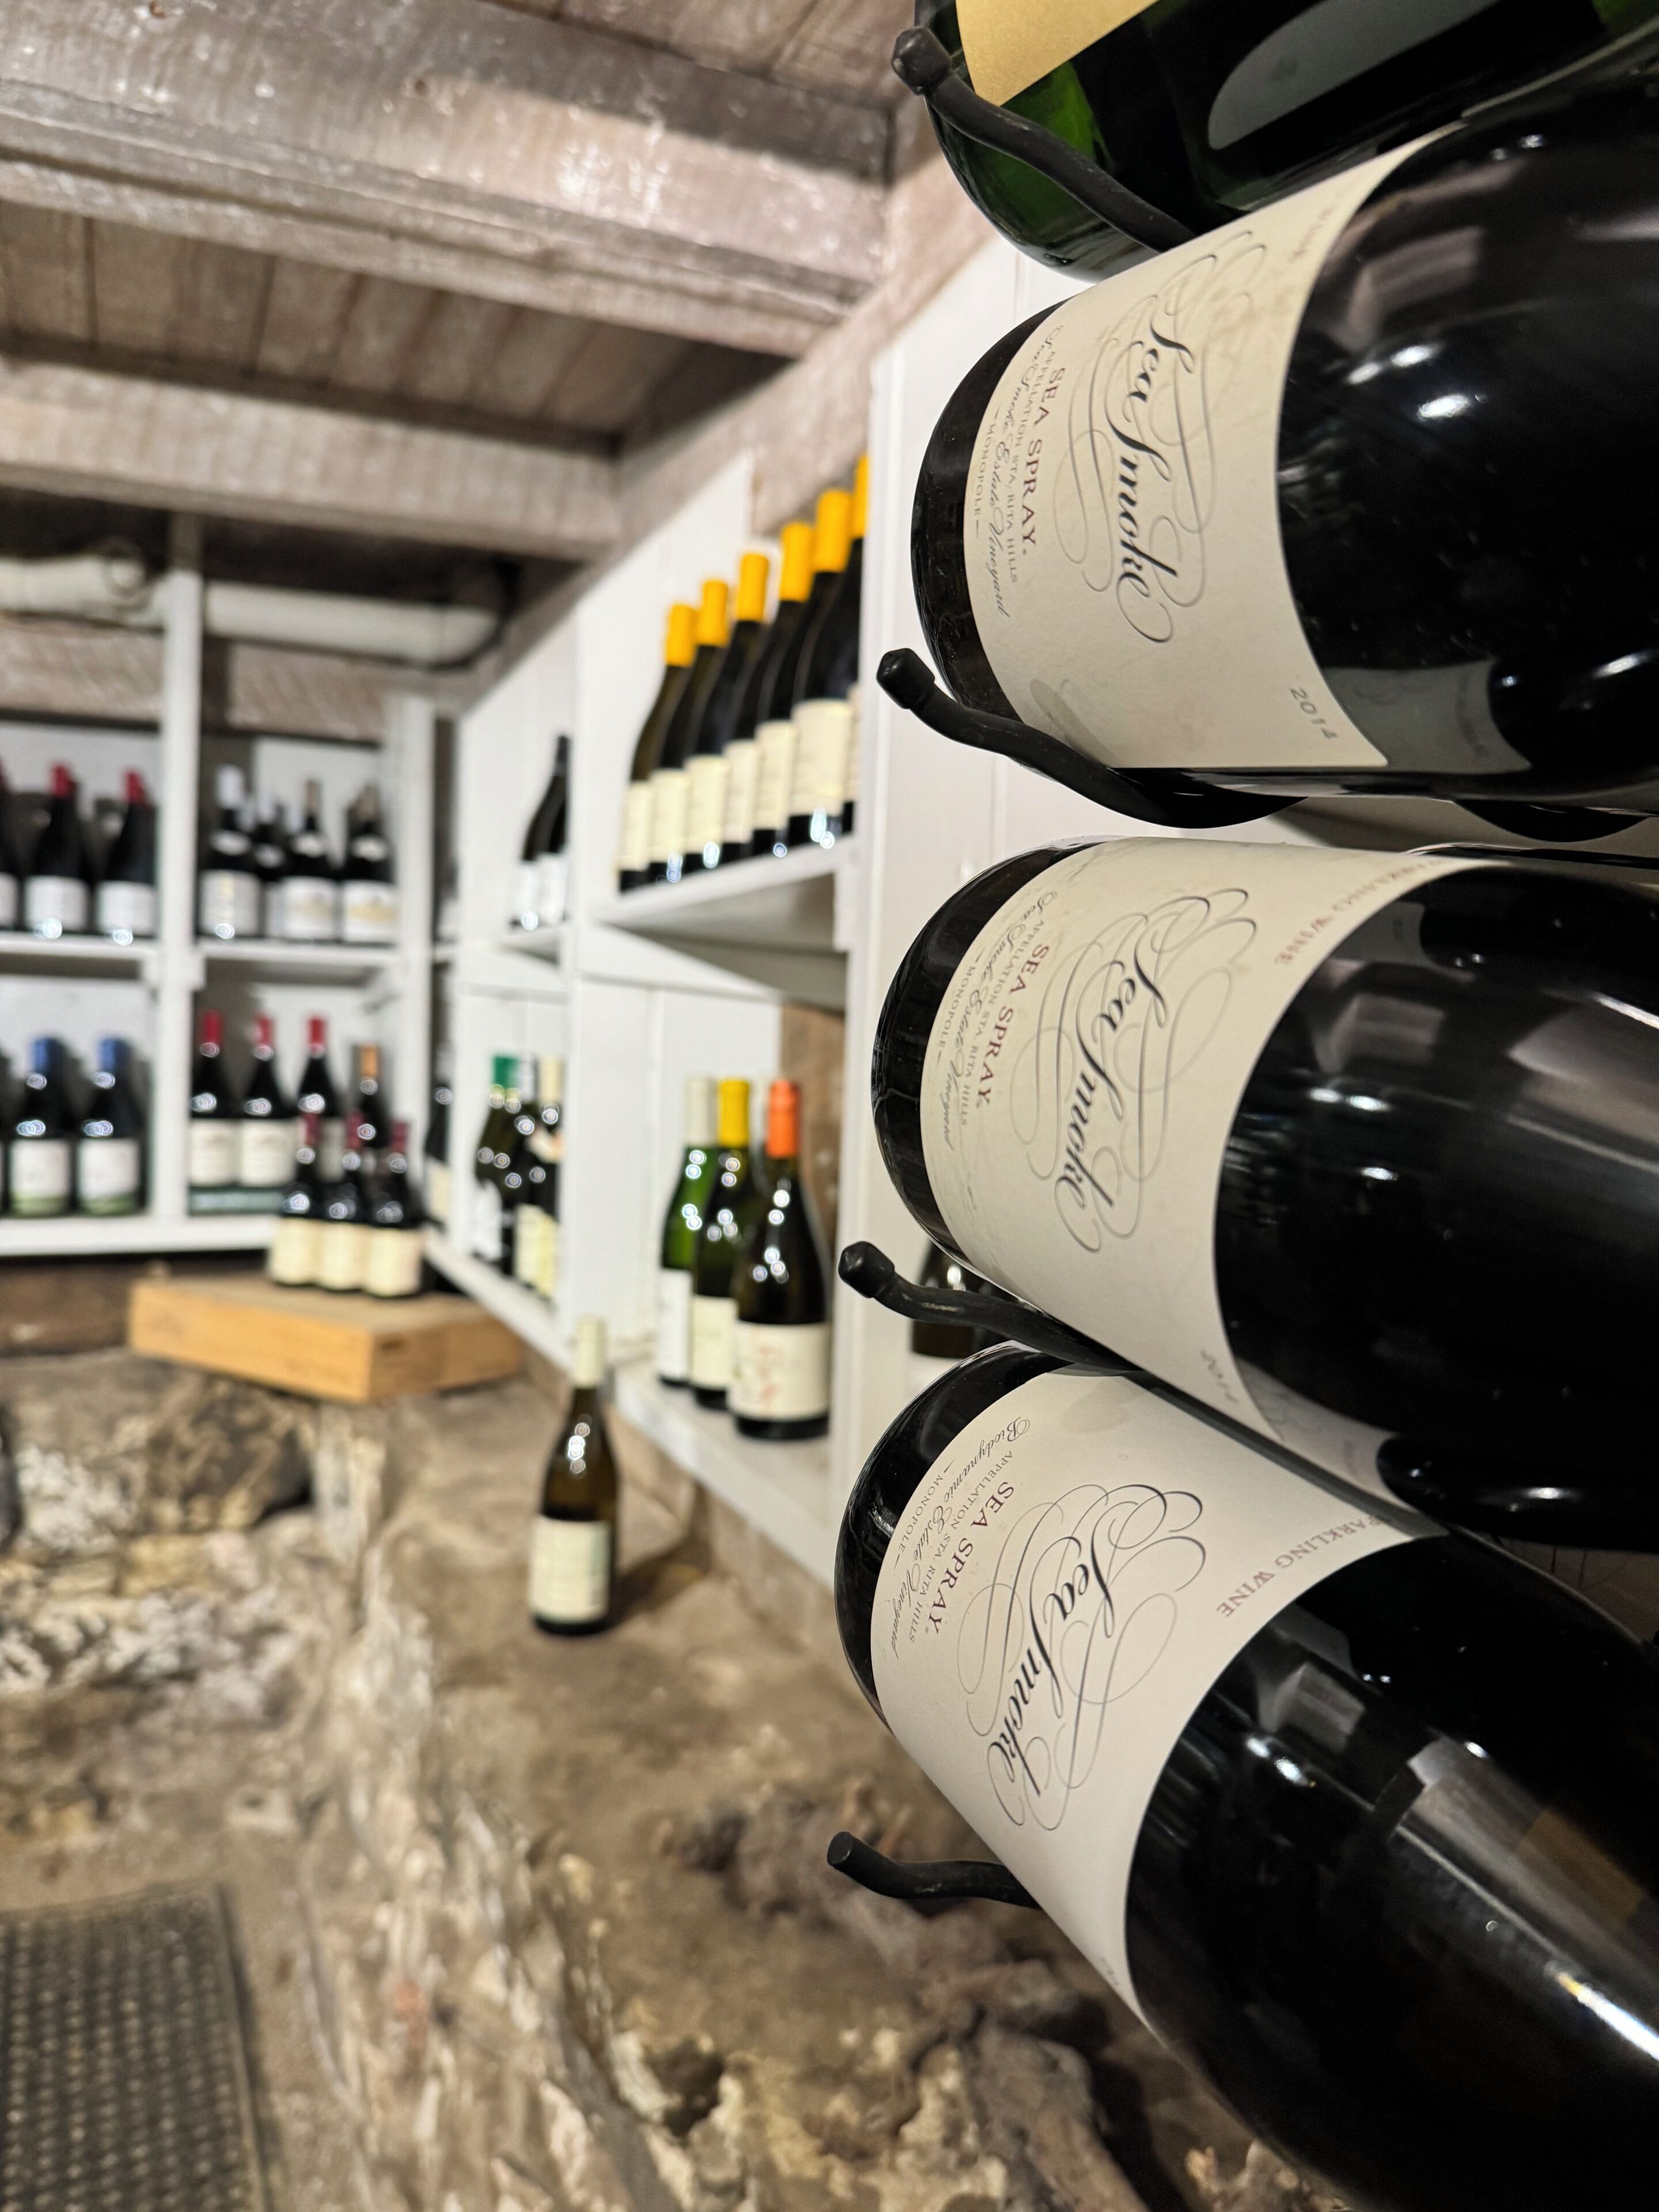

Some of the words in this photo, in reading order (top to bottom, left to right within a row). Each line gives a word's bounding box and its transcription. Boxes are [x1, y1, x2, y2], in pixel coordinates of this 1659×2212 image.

[1032, 324, 1065, 364] Sea
[1003, 364, 1038, 432] Smoke
[1033, 367, 1066, 427] SEA
[989, 433, 1013, 507] Estate
[985, 507, 1010, 618] Vineyard
[1022, 891, 1058, 922] Sea
[980, 924, 1026, 984] Smoke
[1009, 943, 1050, 995] SEA
[954, 986, 989, 1050] Estate
[940, 1049, 964, 1151] Vineyard
[943, 1416, 1031, 1503] Biodynamic
[898, 1474, 944, 1554] MONOPOLE
[950, 1450, 1014, 1531] APPELLATION
[970, 1480, 1015, 1527] SEA
[914, 1505, 952, 1562] Estate
[919, 1565, 935, 1596] RITA
[1216, 1570, 1275, 1618] WINE
[891, 1563, 921, 1660] Vineyard
[909, 1601, 923, 1643] HILLS
